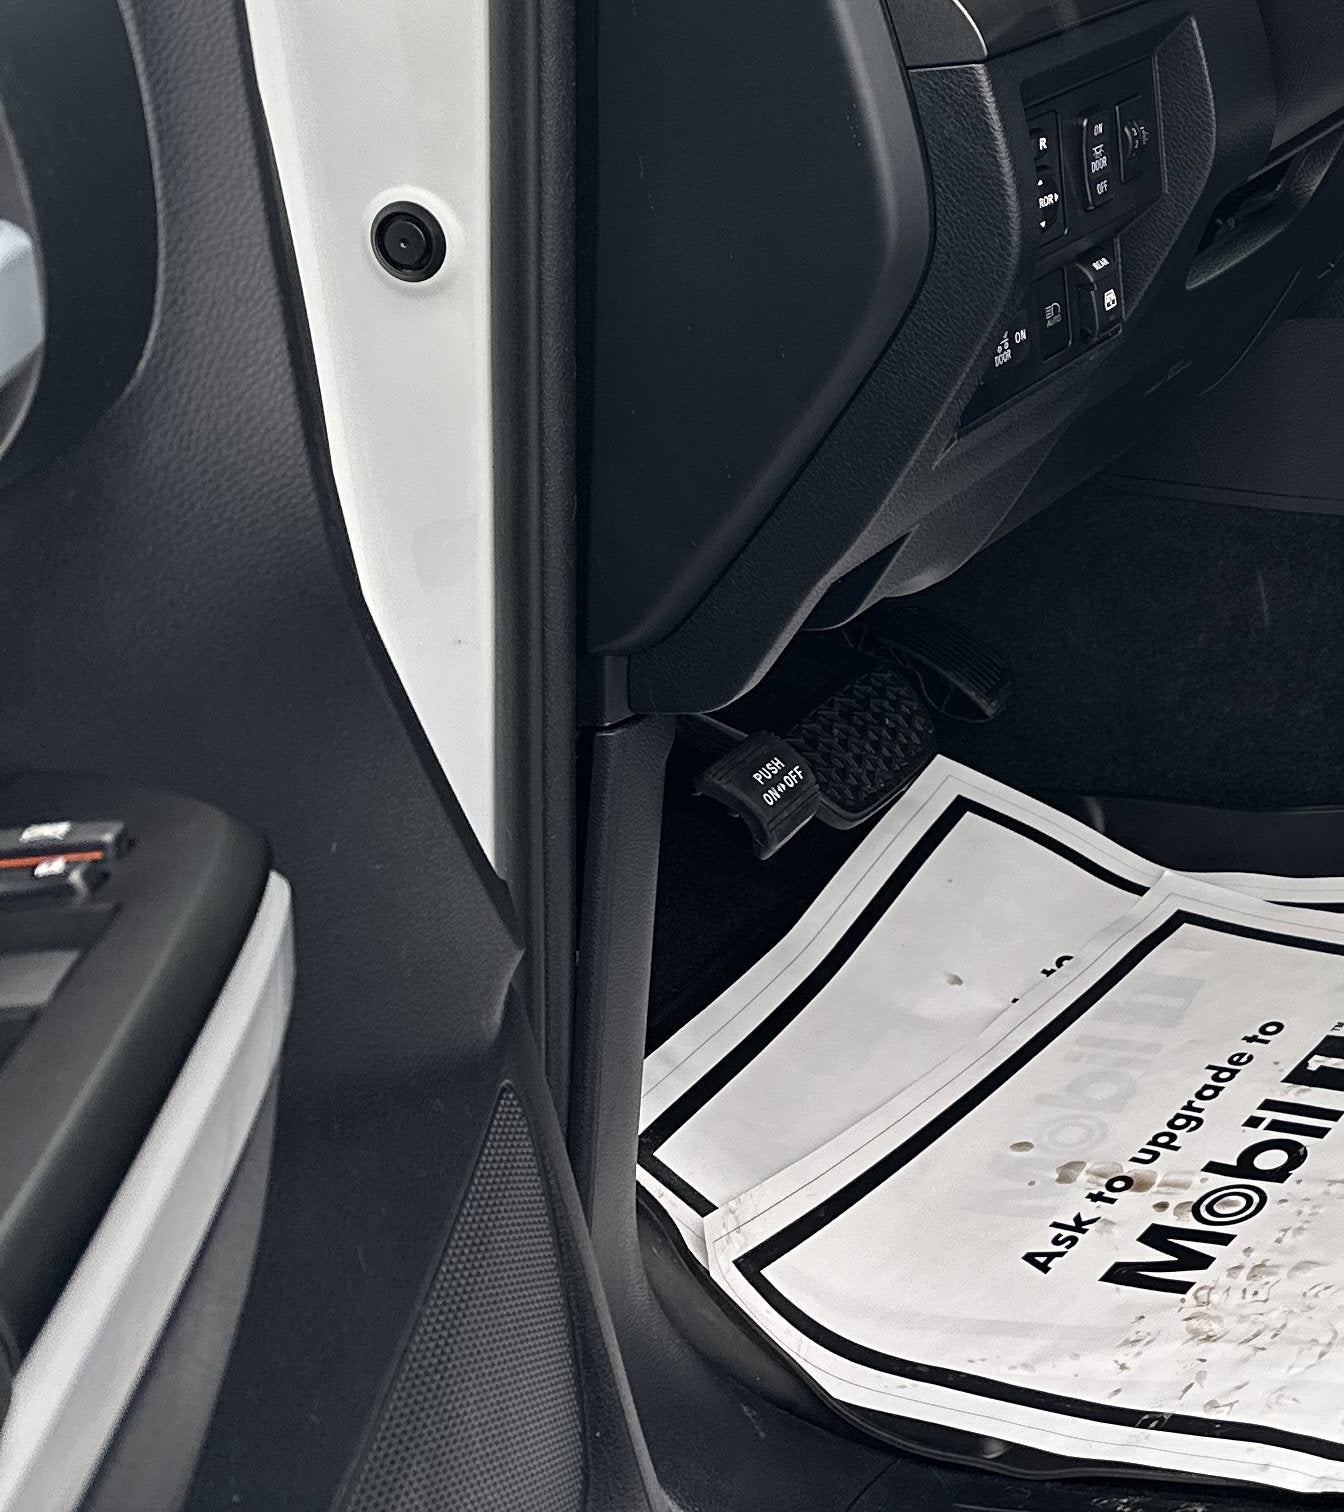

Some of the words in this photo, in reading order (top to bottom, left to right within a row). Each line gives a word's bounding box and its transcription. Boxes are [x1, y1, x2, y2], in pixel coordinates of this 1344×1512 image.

[1093, 123, 1103, 136] ON
[1039, 137, 1047, 150] R
[1091, 156, 1107, 173] DOOR
[1096, 180, 1108, 195] OFF
[1015, 329, 1027, 343] ON
[752, 757, 785, 785] PUSH
[762, 787, 781, 806] ON
[783, 765, 804, 788] OFF
[1021, 1211, 1101, 1275] Ask
[1085, 1175, 1134, 1205] to
[1128, 1051, 1254, 1165] upgrade
[1241, 1020, 1285, 1045] to
